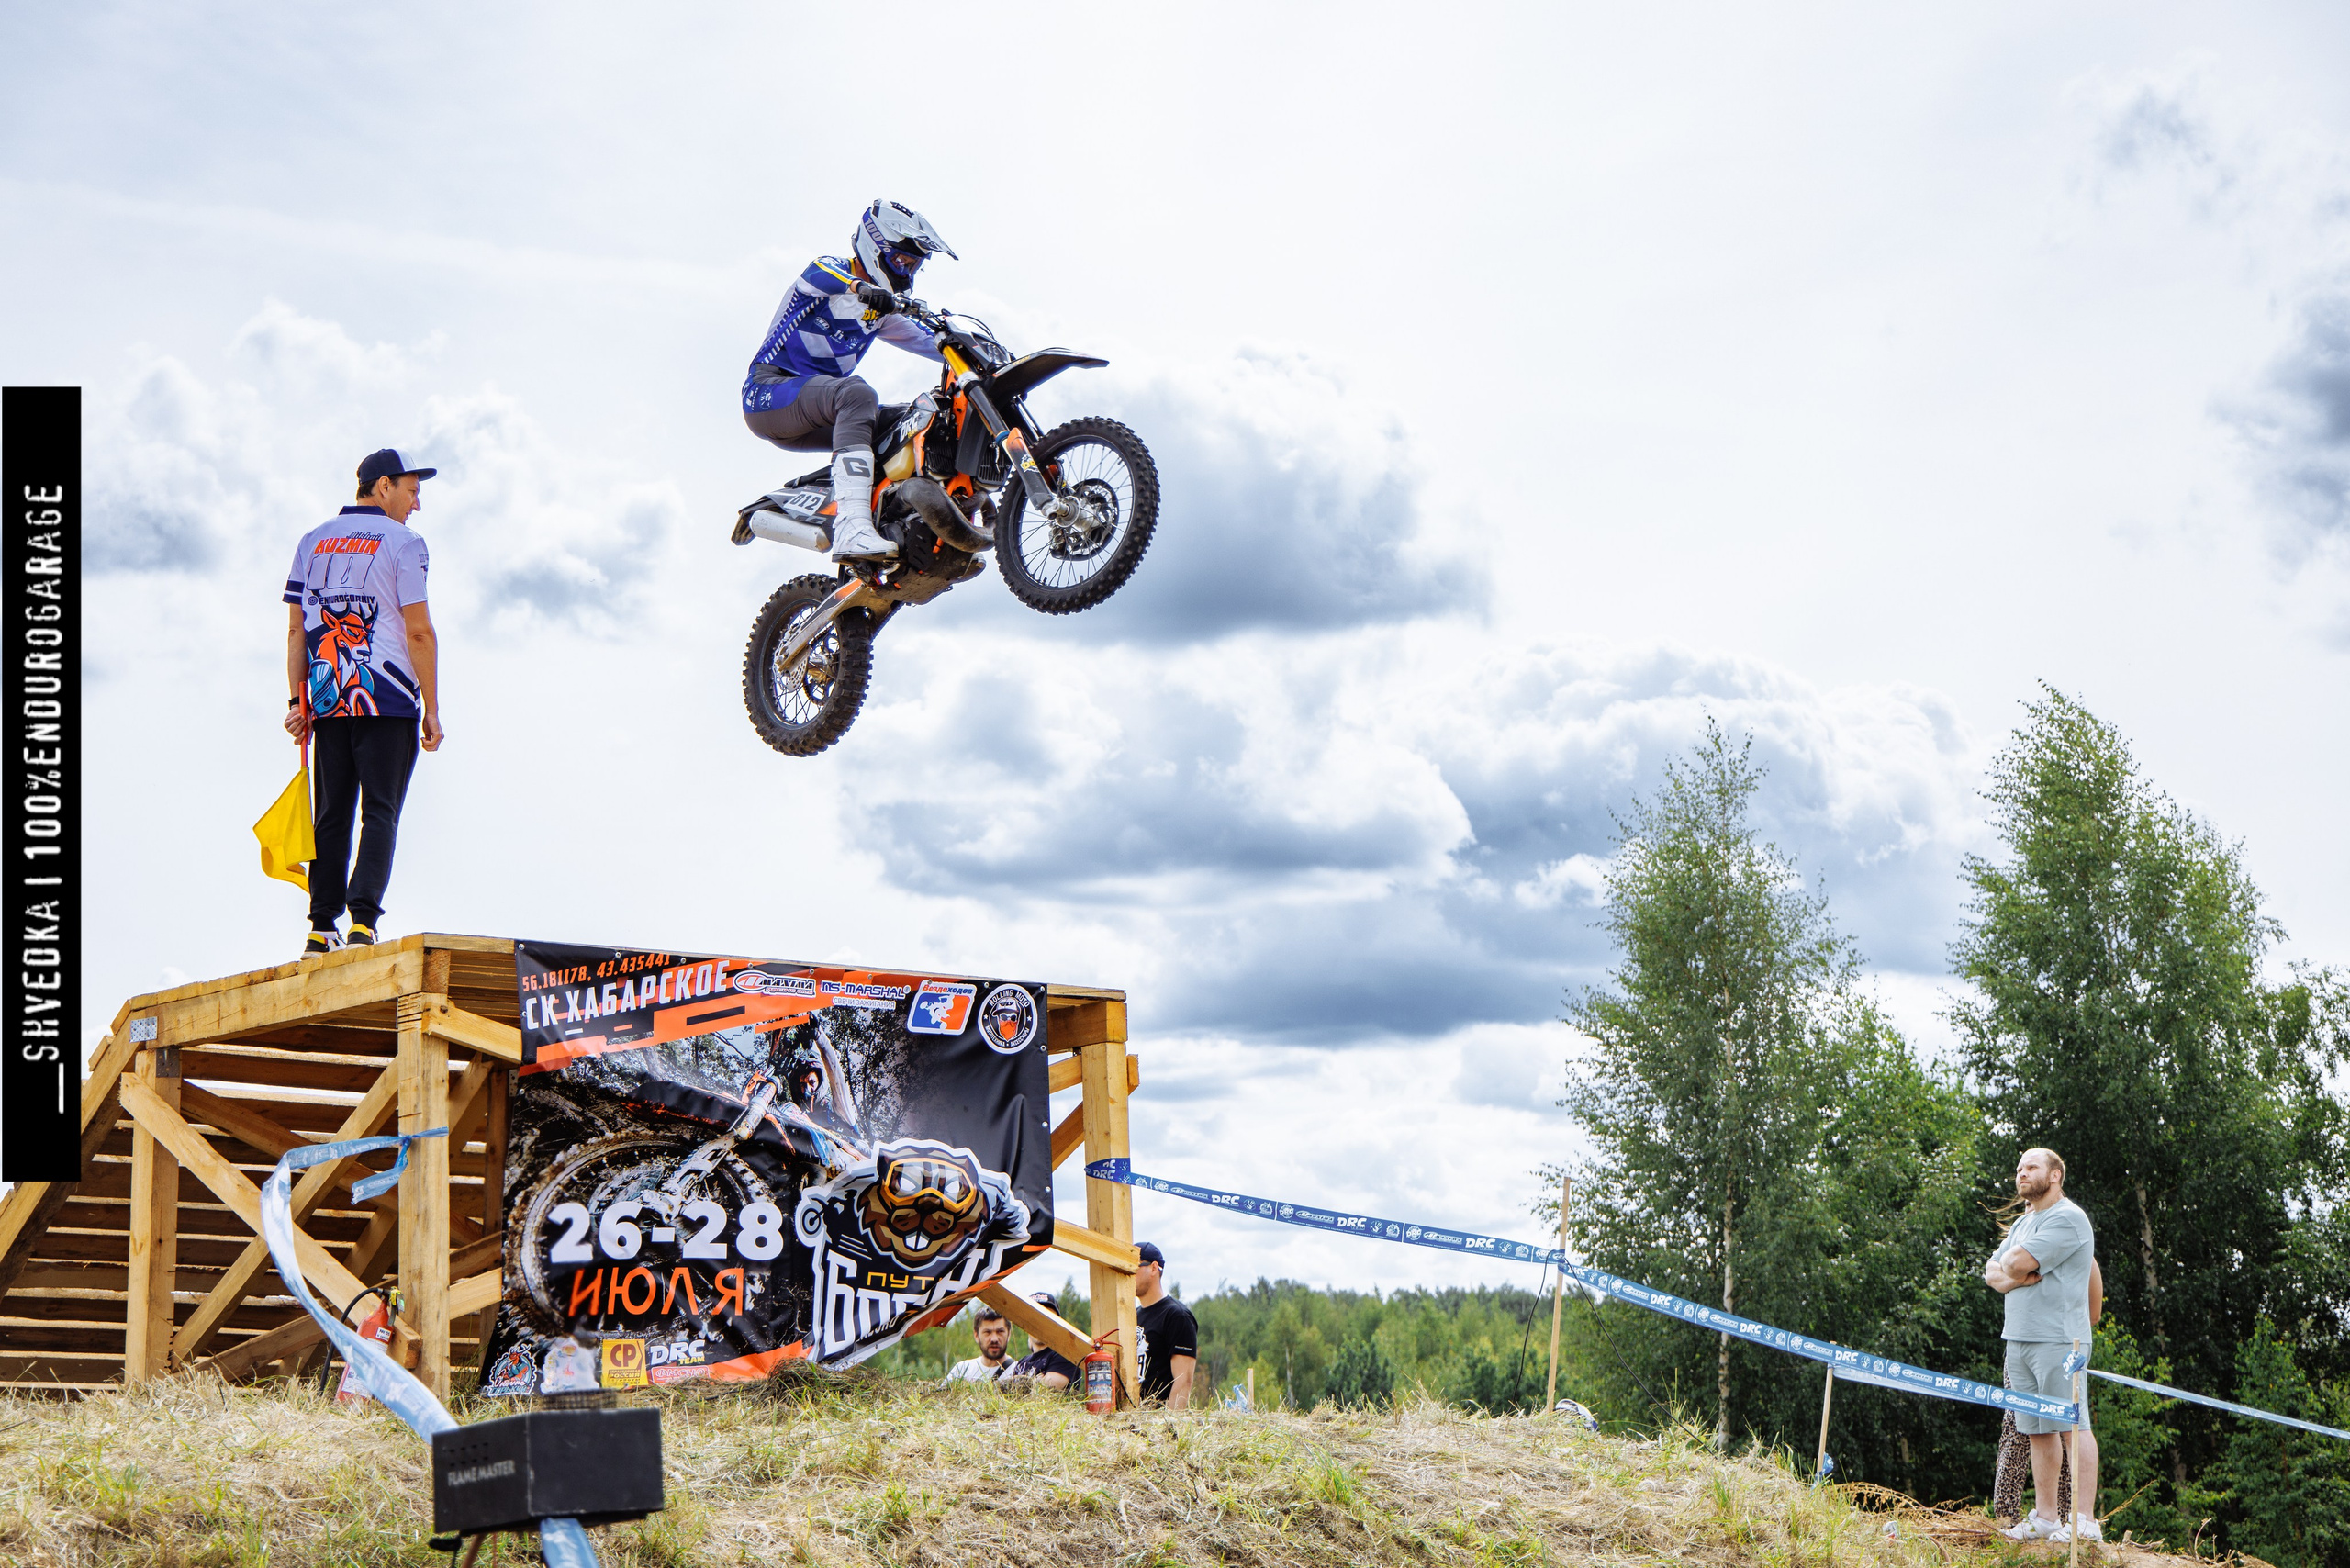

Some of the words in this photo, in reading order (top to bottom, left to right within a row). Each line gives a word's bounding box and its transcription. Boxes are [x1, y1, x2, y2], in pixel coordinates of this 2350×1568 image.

[863, 217, 892, 253] 100%
[789, 494, 822, 511] 012
[314, 538, 382, 554] KUZMIN
[306, 553, 375, 590] 10
[522, 965, 591, 992] 56.181178,
[597, 953, 670, 979] 43.435441
[525, 993, 559, 1030] СК
[565, 960, 731, 1023] ХАБАРСКОЕ
[922, 984, 974, 995] Вездеходов
[834, 997, 855, 1005] СВЕЧИ
[856, 998, 896, 1009] ЗАЖИГАНИЯ
[989, 990, 1013, 1006] ROLLING
[1015, 991, 1030, 1007] MOTO
[1092, 1169, 1115, 1180] DRC
[1212, 1194, 1240, 1205] DRC
[1337, 1217, 1367, 1227] DRC
[548, 1201, 784, 1263] 26-28
[1465, 1238, 1495, 1249] DRC
[867, 1271, 942, 1291] ПУТ
[567, 1267, 744, 1317] ИЮЛЯ
[1651, 1294, 1673, 1305] DRC
[1740, 1323, 1762, 1334] DRC
[650, 1339, 705, 1365] DRC
[1835, 1350, 1859, 1361] DRC
[678, 1356, 705, 1364] TEAM
[1935, 1377, 1960, 1388] DRC
[2039, 1403, 2065, 1414] DRC
[448, 1468, 476, 1486] FLAME
[477, 1460, 515, 1481] MASTER
